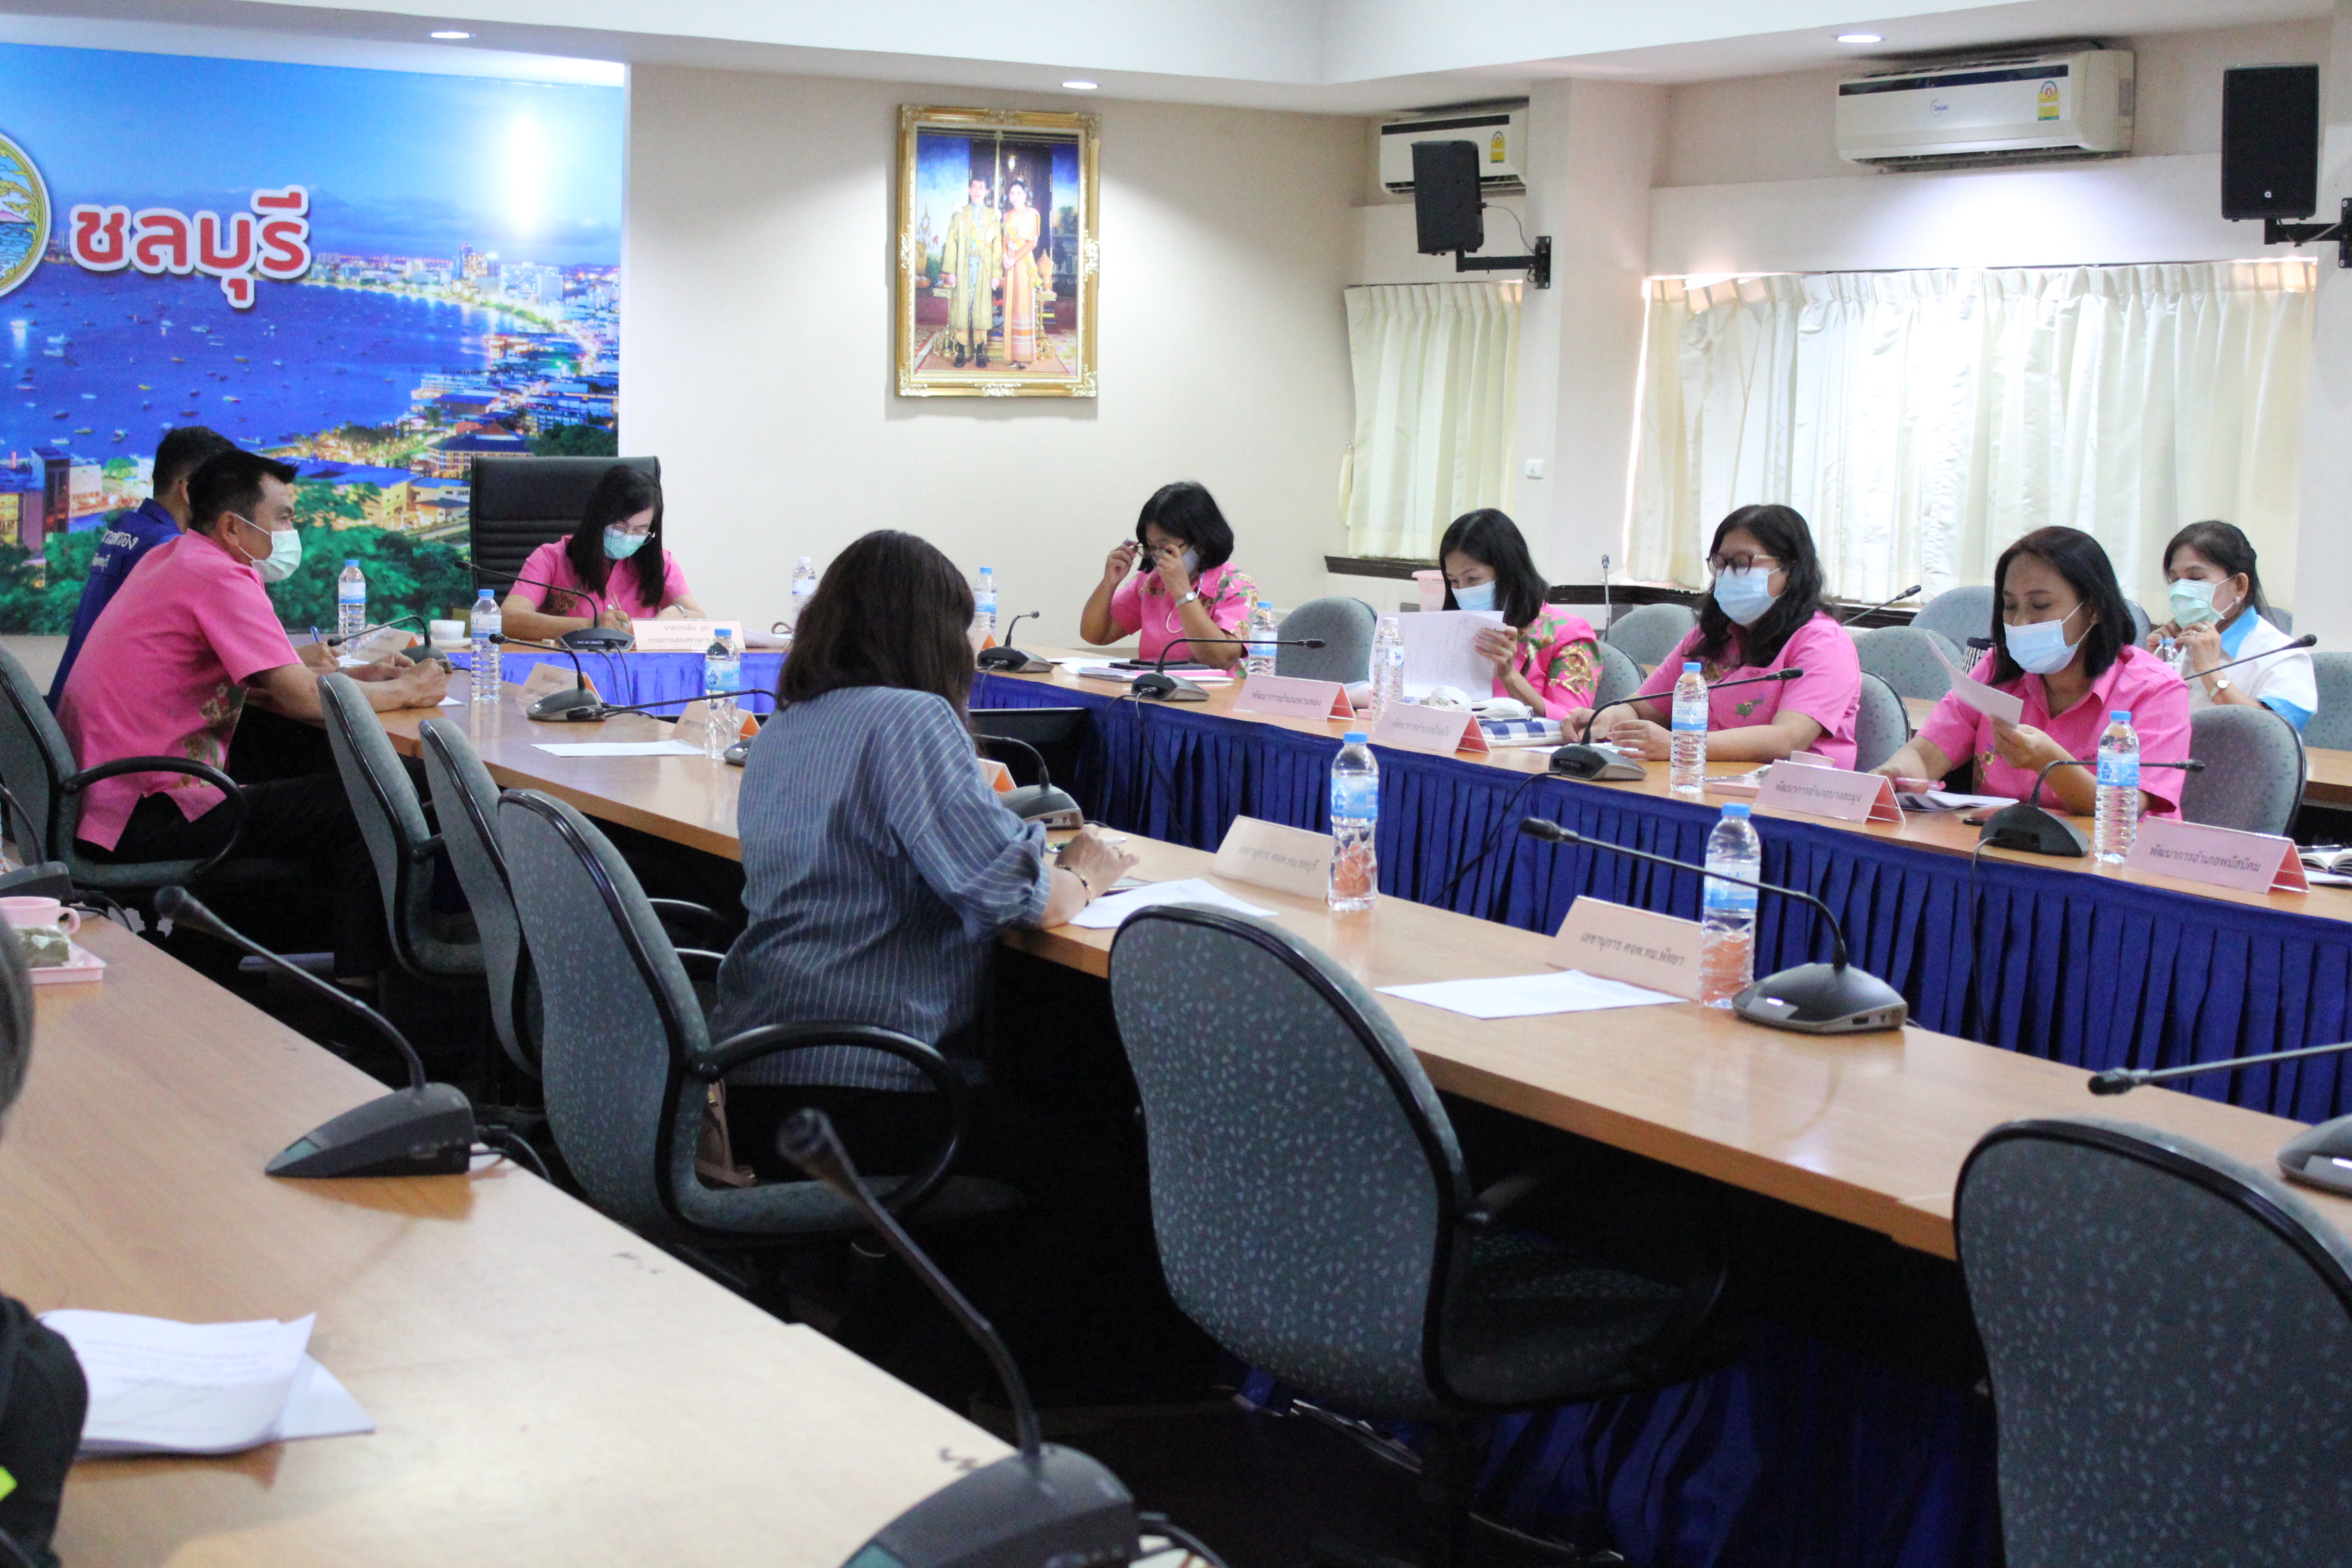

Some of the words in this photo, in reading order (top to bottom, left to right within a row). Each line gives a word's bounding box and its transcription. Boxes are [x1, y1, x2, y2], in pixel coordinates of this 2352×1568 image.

[71, 187, 310, 306] ชลบุรี
[1252, 689, 1322, 706] พัฒนาการอำเภอพานทอง
[1774, 780, 1862, 806] พัฒนาการอำเภอบางละมุง
[2149, 843, 2262, 872] พัฒนาการอำเภอพนัสนิคม
[1580, 932, 1622, 952] เลขานุการ
